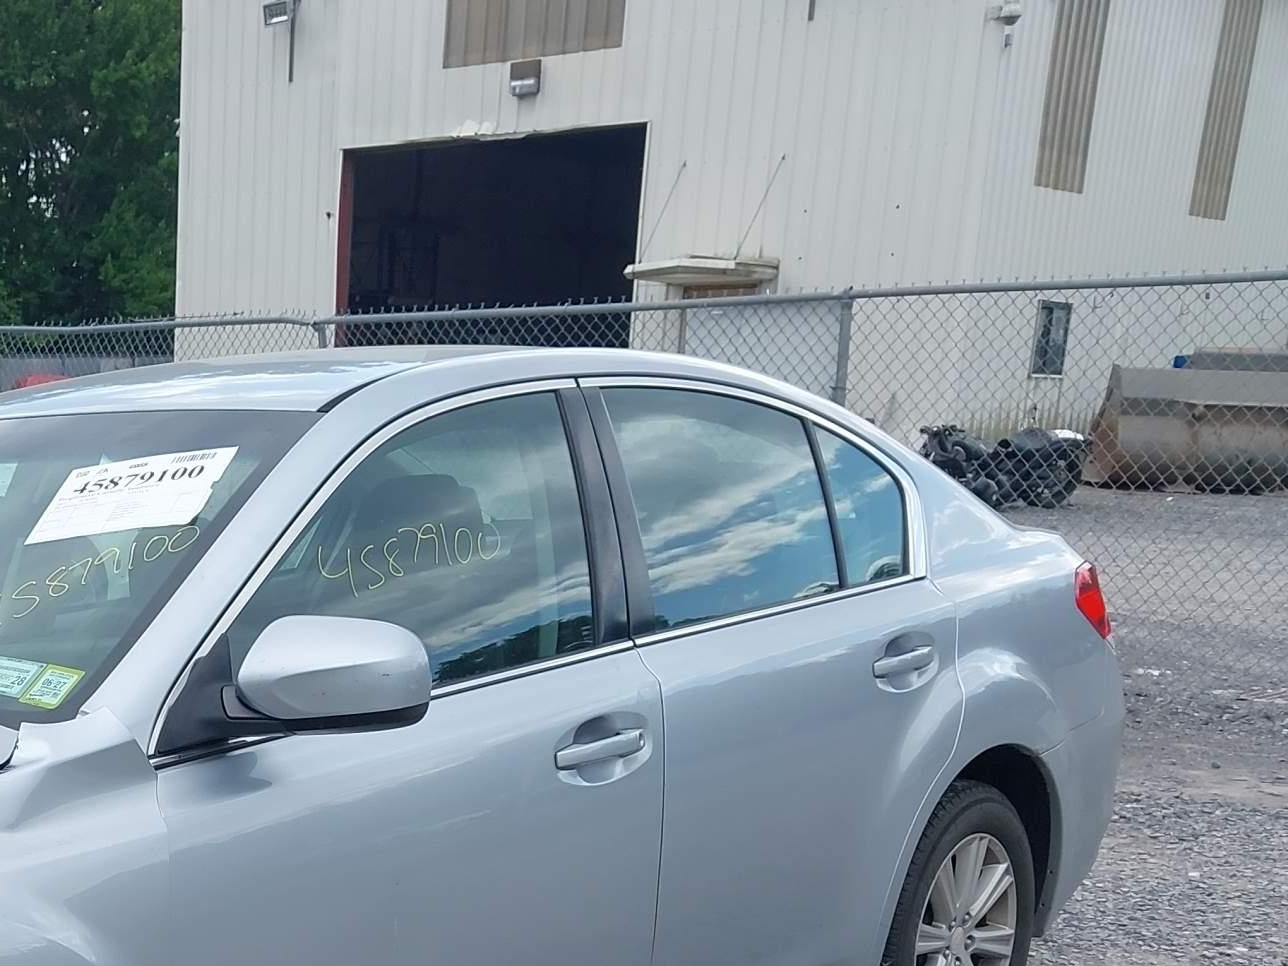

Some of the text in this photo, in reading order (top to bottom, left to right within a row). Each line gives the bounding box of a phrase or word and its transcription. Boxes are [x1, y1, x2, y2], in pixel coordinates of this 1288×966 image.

[73, 464, 206, 494] 45879100
[318, 523, 501, 598] 45879100
[10, 675, 27, 686] 28
